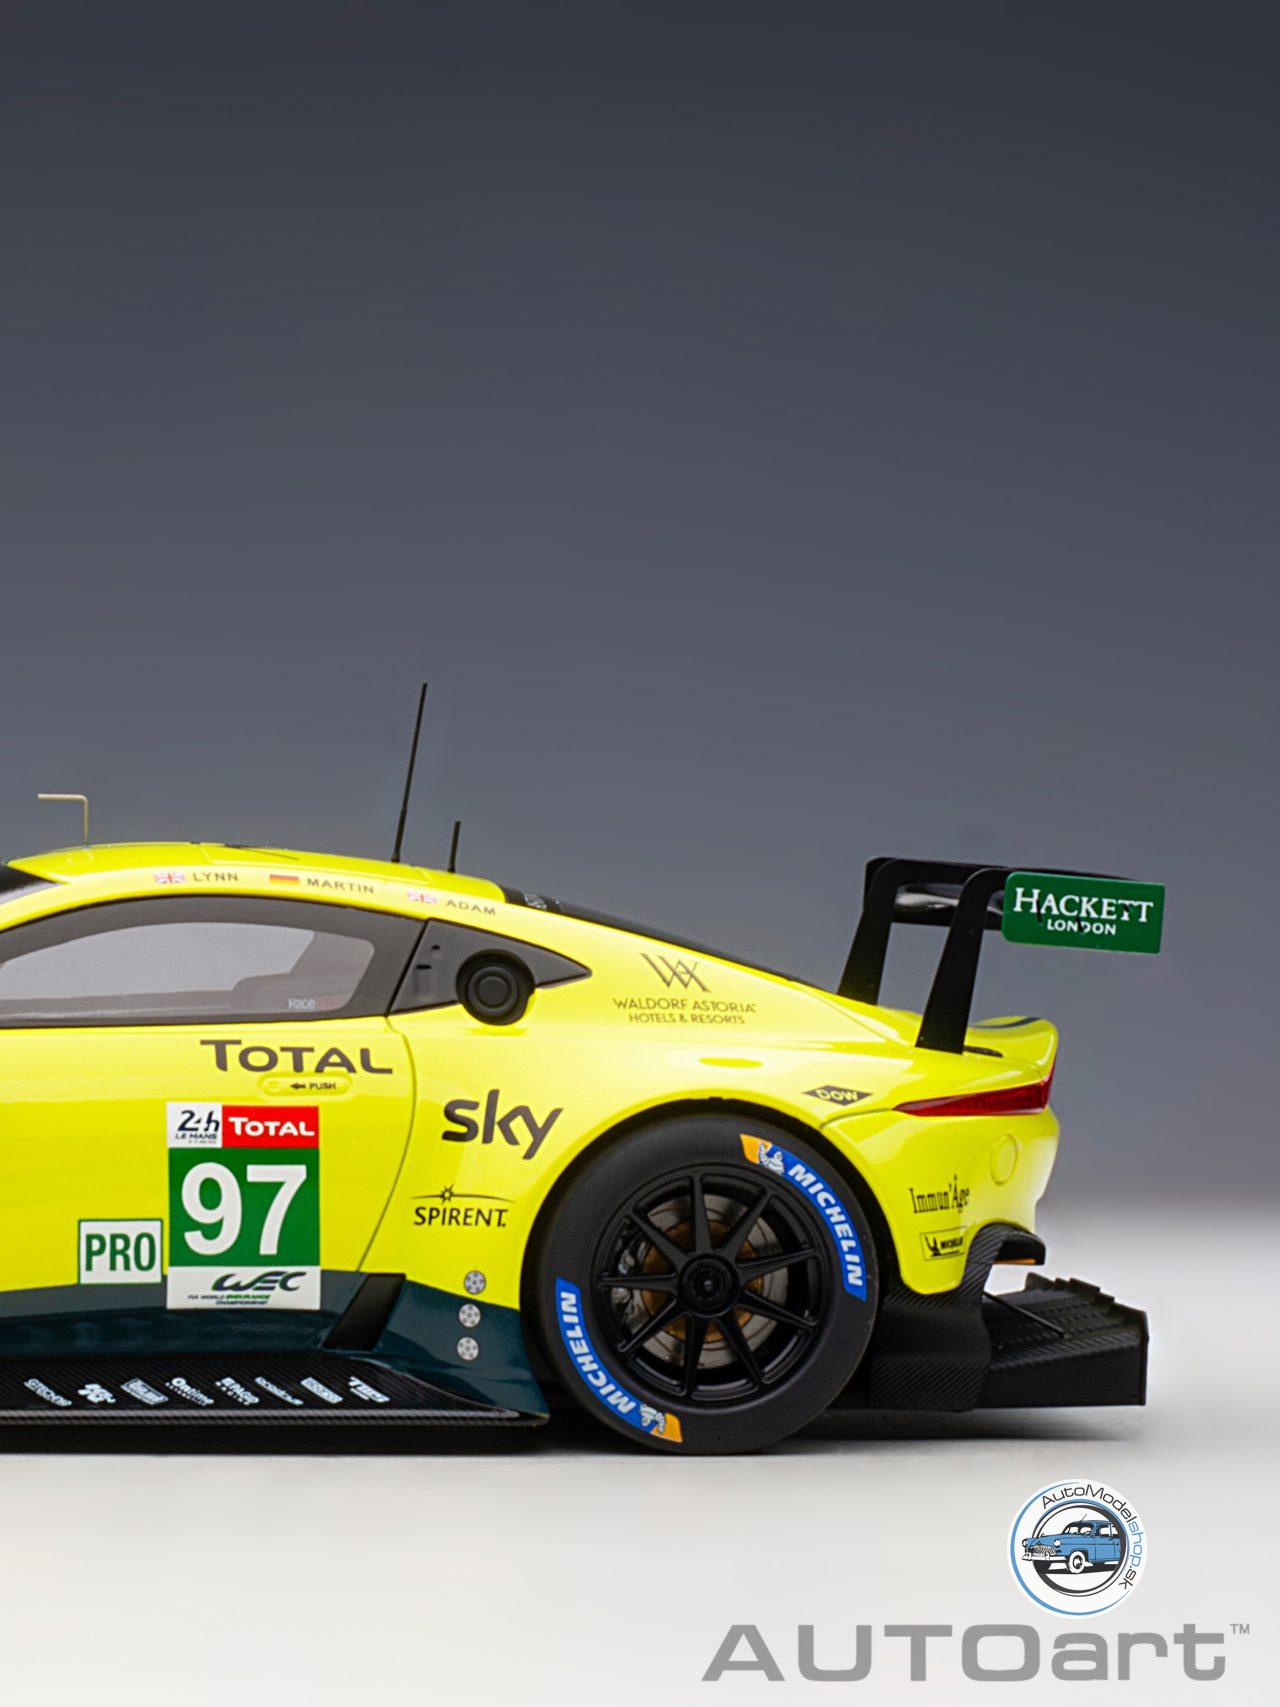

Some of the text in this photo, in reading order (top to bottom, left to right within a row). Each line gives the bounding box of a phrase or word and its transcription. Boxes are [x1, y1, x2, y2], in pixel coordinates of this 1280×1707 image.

[193, 872, 239, 882] LYNN
[307, 878, 375, 894] MARTIN
[446, 899, 497, 916] ADAM
[1013, 887, 1154, 922] HACKETT
[1047, 918, 1117, 936] LONDON
[613, 997, 756, 1014] WALDORF ASTORIA
[628, 1013, 746, 1025] HOTELS & RESORTS
[200, 1039, 393, 1074] TOTAL
[228, 1116, 315, 1137] TOTAL
[441, 1089, 563, 1160] sky
[181, 1162, 307, 1256] 97
[787, 1164, 863, 1287] MICHELIN
[85, 1232, 156, 1272] PRO
[560, 1291, 636, 1414] MICHELIN
